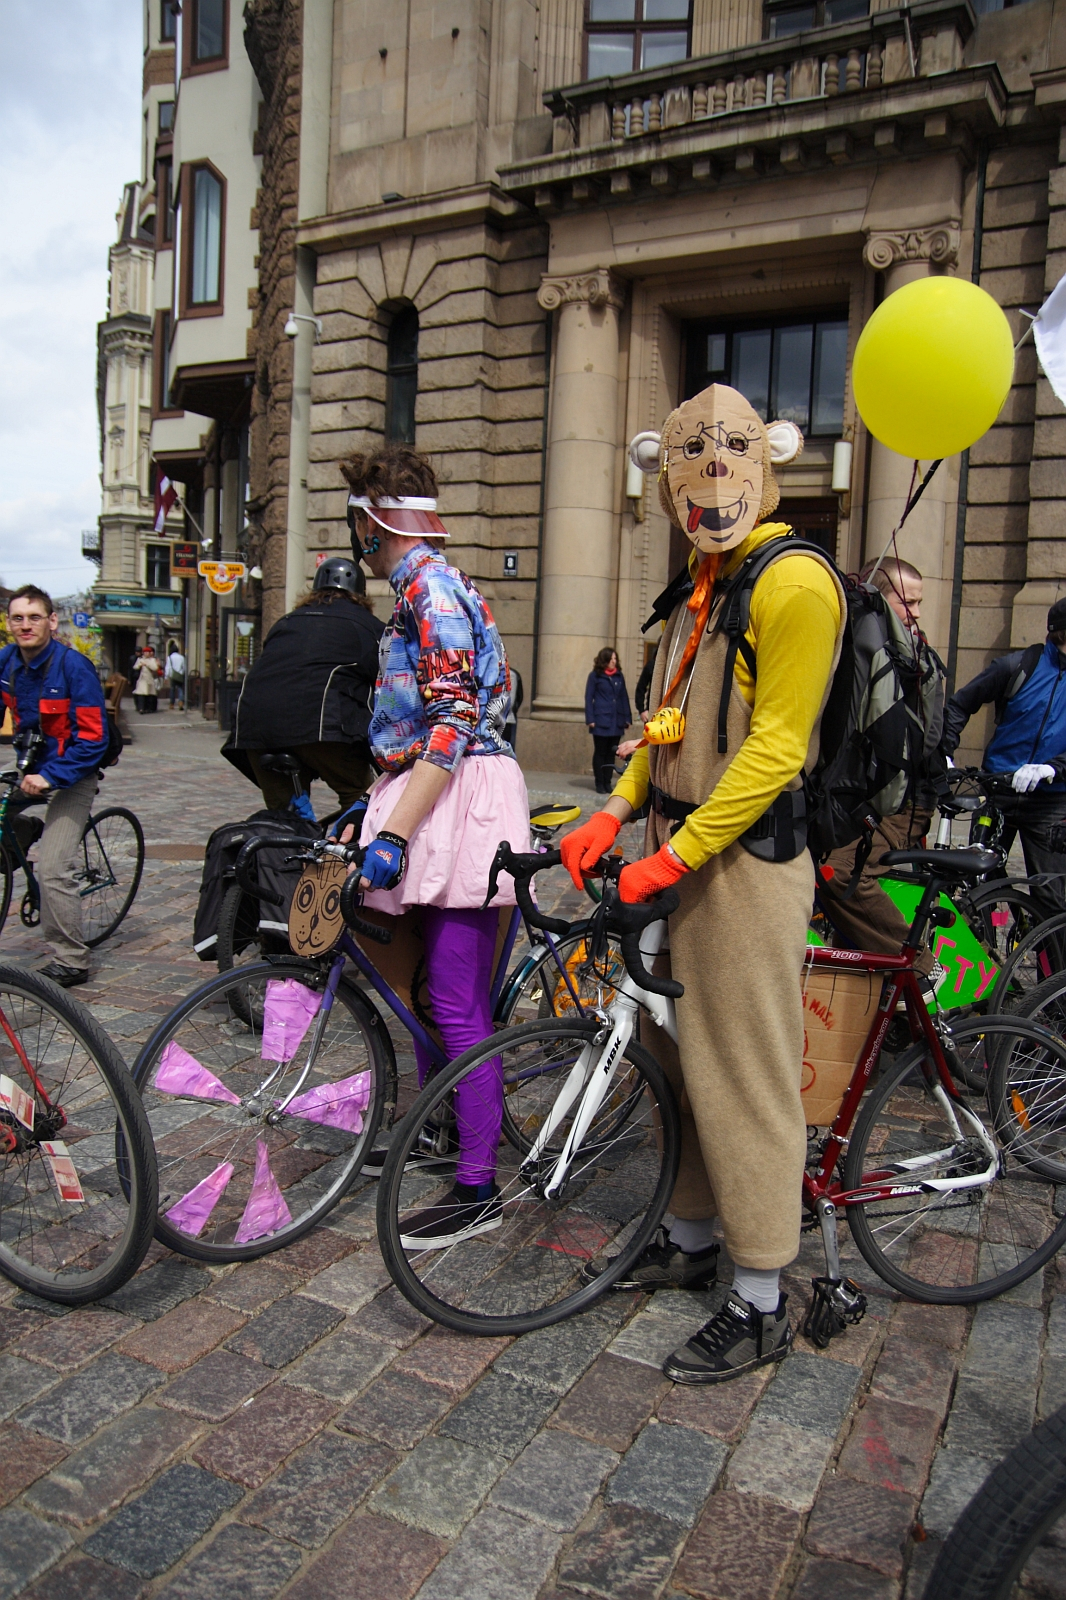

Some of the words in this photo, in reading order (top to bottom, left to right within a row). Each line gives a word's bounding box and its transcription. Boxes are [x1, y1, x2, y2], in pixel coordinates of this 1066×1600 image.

[507, 557, 514, 568] 8
[603, 1036, 622, 1076] MBK
[889, 1184, 923, 1195] MBK
